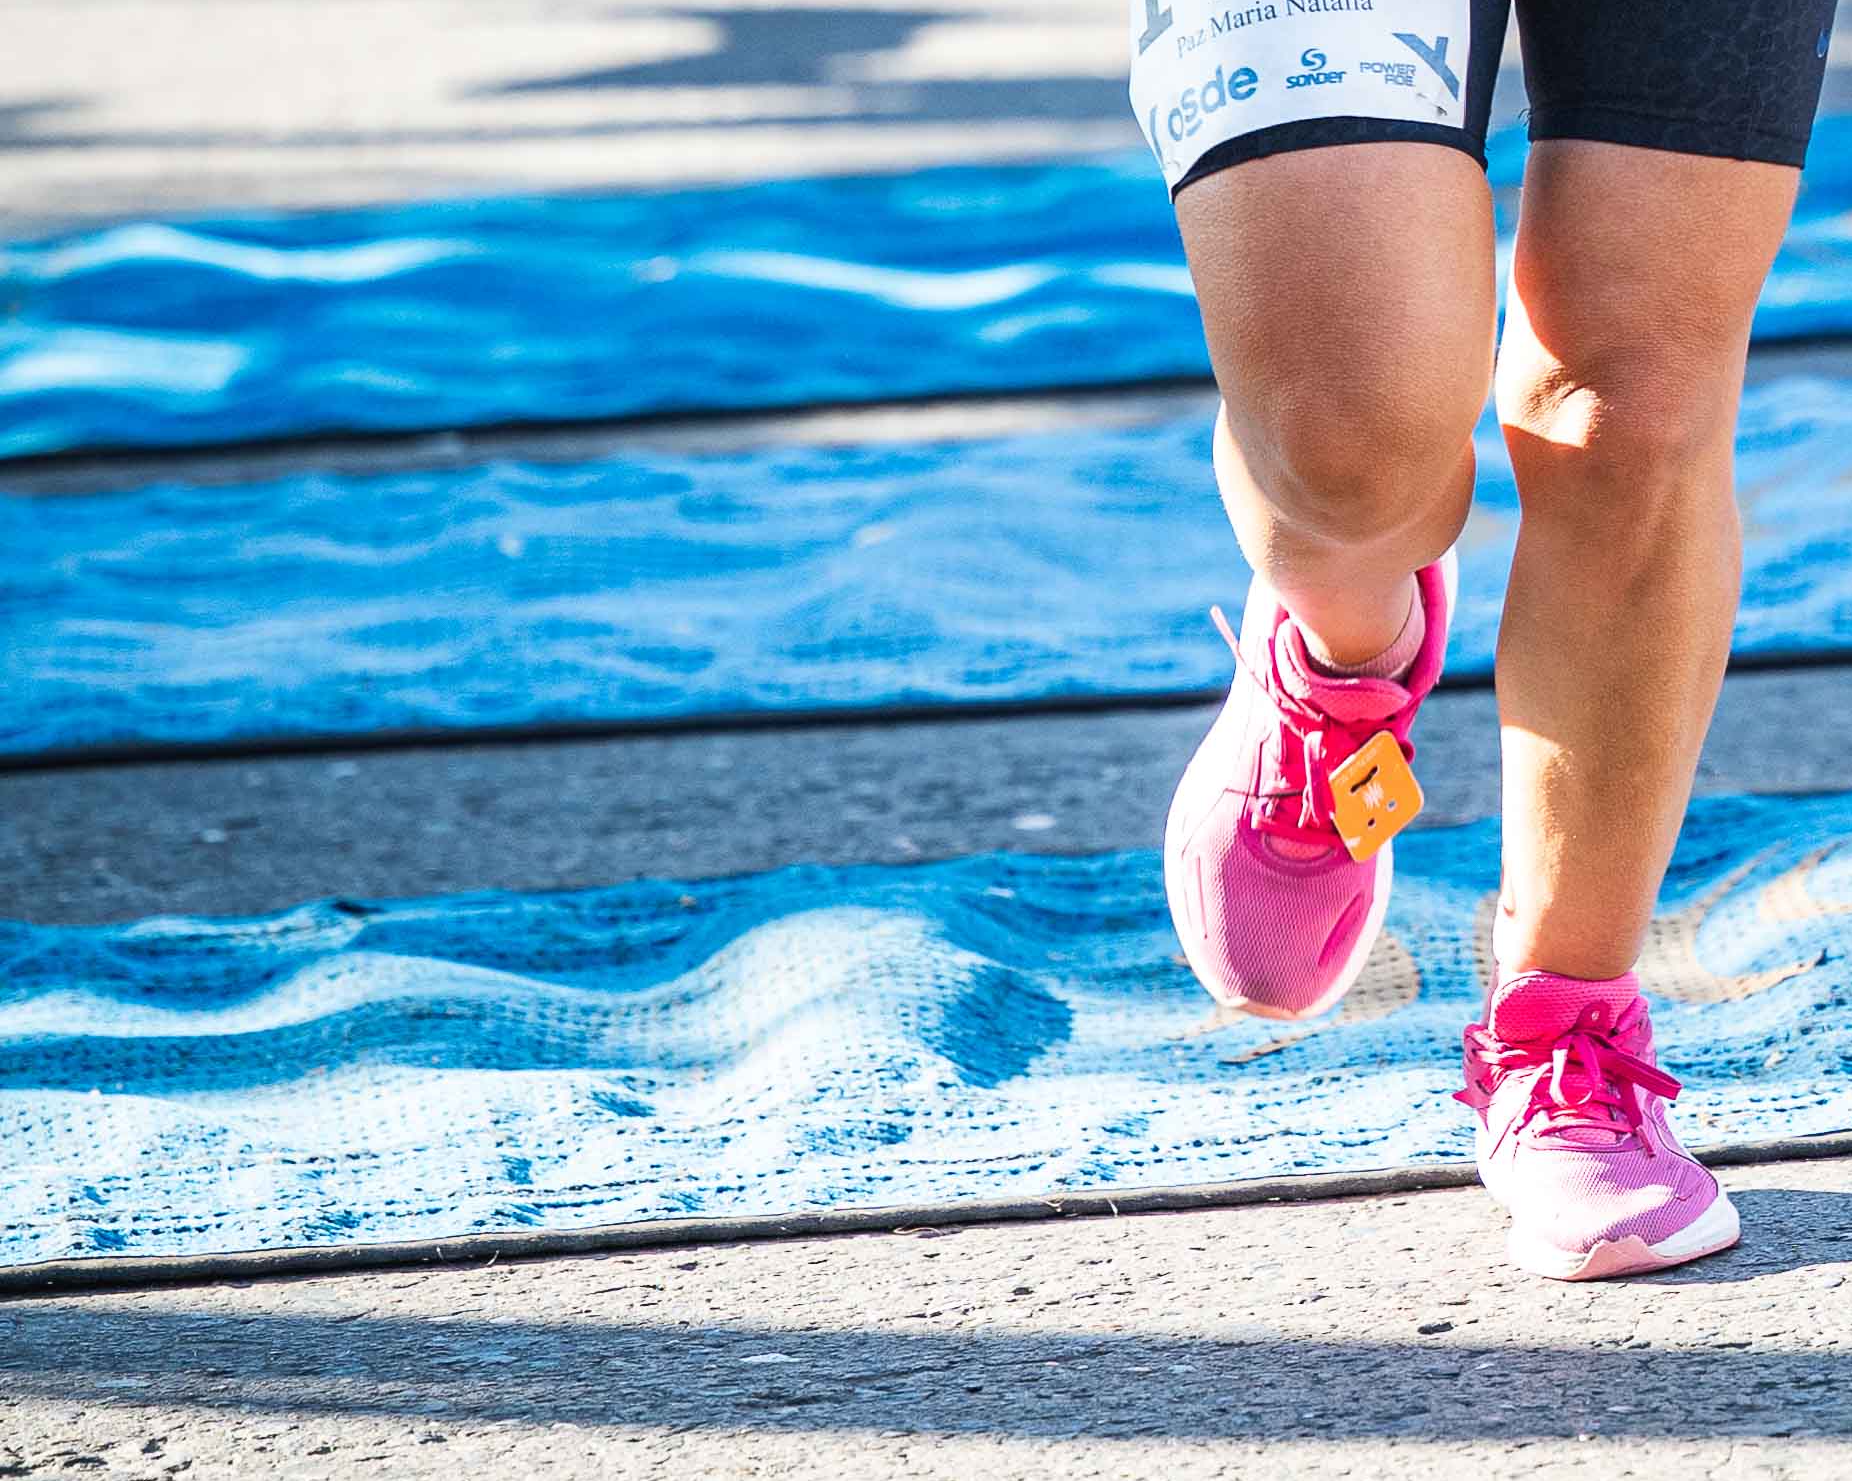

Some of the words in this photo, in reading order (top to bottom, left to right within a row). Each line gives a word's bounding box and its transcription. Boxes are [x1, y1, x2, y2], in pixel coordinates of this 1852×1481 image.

[1176, 28, 1206, 58] Paz
[1210, 0, 1277, 38] Maria
[1360, 61, 1417, 77] POWER
[1167, 64, 1259, 142] osde
